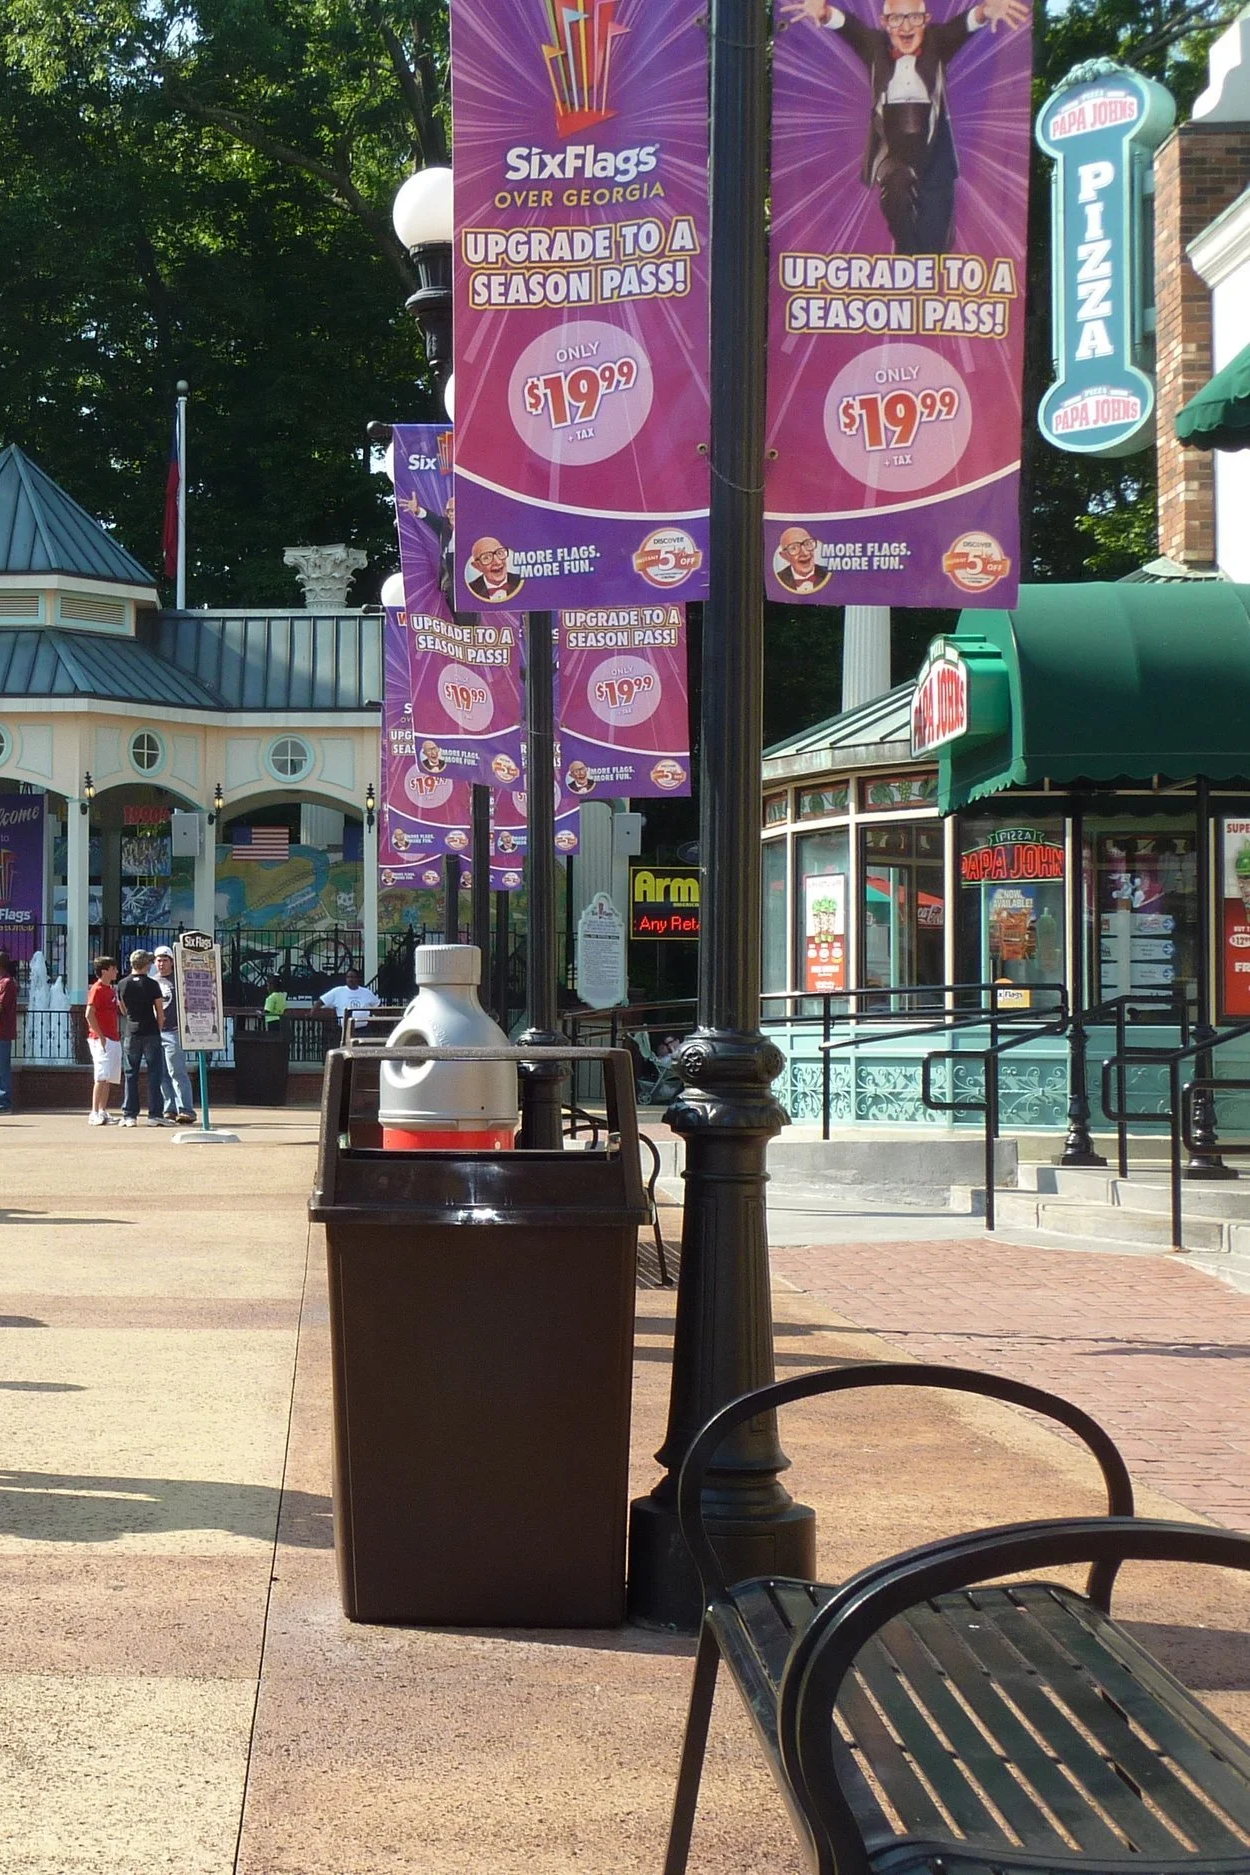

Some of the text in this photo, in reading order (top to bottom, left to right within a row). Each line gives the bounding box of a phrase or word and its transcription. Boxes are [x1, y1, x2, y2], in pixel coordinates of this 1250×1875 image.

[1052, 100, 1134, 137] PAPA JOHNS
[495, 181, 665, 208] OVER GEORGIA
[464, 218, 697, 264] UPGRADE TO A
[1075, 160, 1114, 361] PIZZA
[472, 259, 688, 306] SEASON PASS!
[781, 255, 1015, 295] UPGRADE TO A
[788, 297, 1006, 337] SEASON PASS!
[556, 341, 600, 363] ONLY
[875, 366, 919, 383] ONLY
[1055, 399, 1138, 431] PAPA JOHNS
[575, 428, 595, 441] TAX
[408, 454, 437, 470] Six
[893, 454, 912, 465] TAX
[514, 545, 600, 565] MORE FLAGS.
[822, 542, 911, 557] MORE FLAGS.
[520, 559, 594, 578] MORE FUN.
[827, 556, 904, 571] MORE FUN.
[564, 608, 681, 627] UPGRADE TO A
[411, 615, 472, 644] UPGRADE
[475, 627, 497, 645] TO
[500, 628, 513, 645] A
[568, 631, 629, 648] SEASON
[633, 628, 677, 646] PASS!
[417, 634, 509, 664] SEASON PASS!
[611, 665, 633, 676] ONLY
[0, 834, 10, 842] to
[1001, 831, 1032, 841] PIZZA
[639, 916, 667, 933] Any
